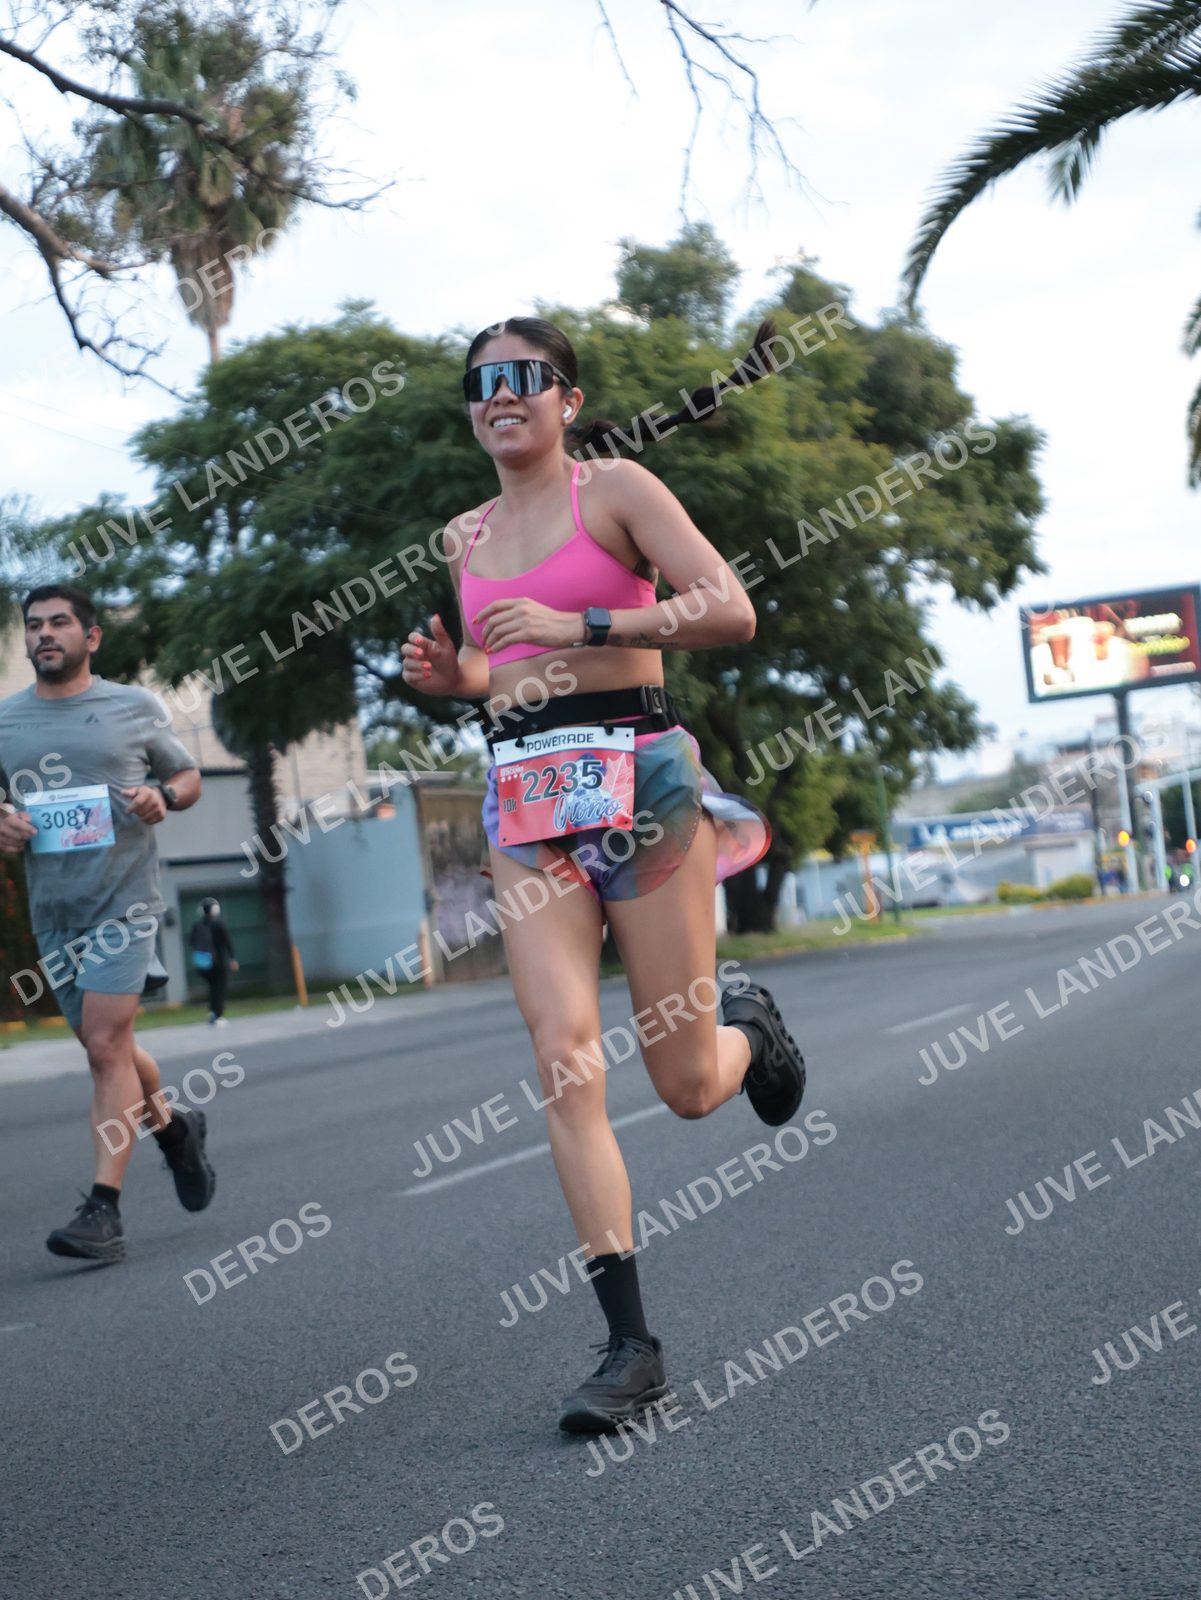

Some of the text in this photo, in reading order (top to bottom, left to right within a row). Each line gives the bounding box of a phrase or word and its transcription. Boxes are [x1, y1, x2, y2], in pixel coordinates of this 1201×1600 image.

[527, 733, 595, 752] POWERADE
[521, 760, 604, 804] 2235
[41, 808, 92, 830] 3087
